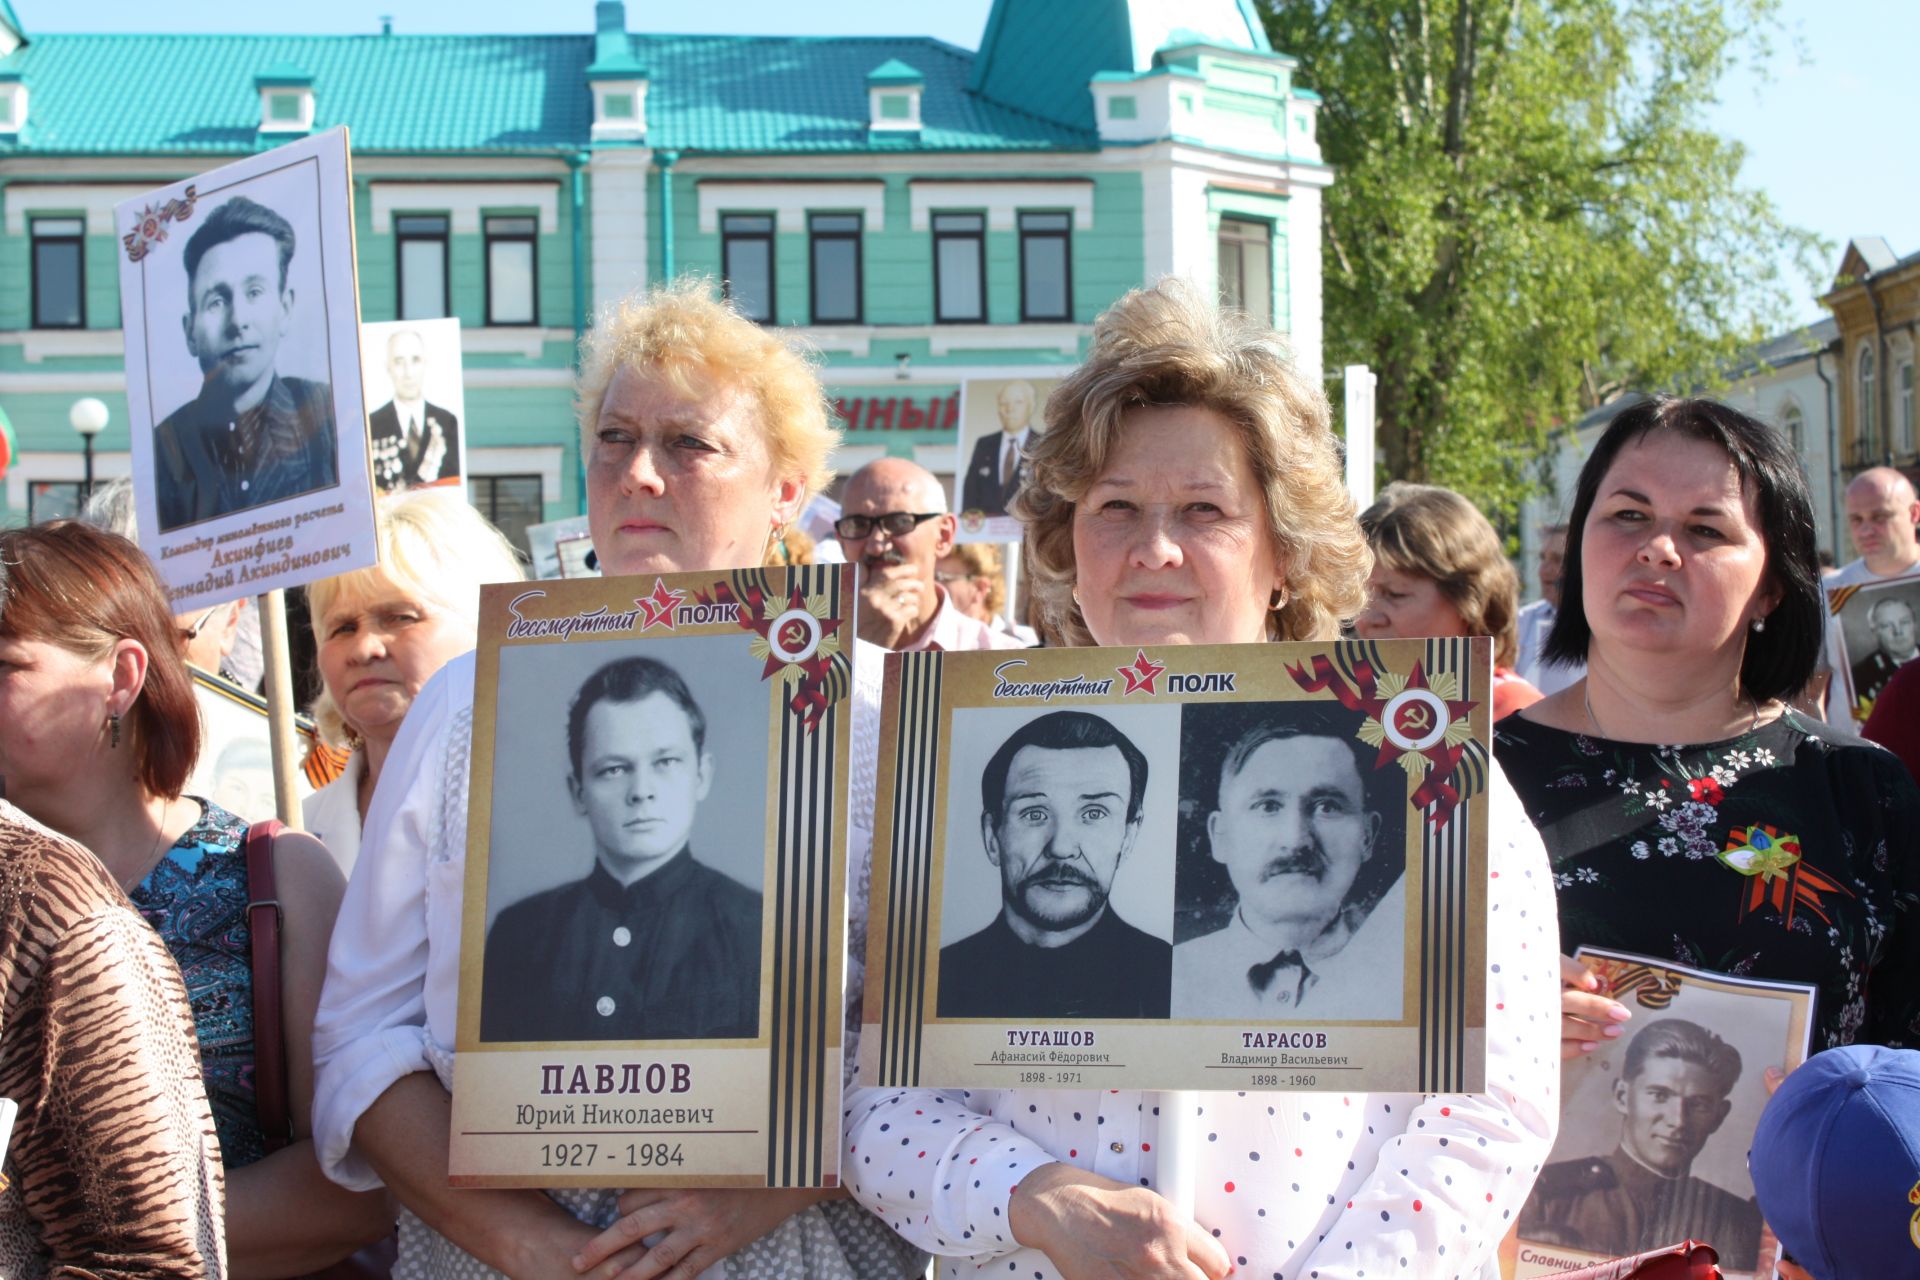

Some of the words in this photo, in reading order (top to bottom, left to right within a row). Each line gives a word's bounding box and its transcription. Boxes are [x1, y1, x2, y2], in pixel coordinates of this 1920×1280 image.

[160, 537, 214, 560] Командир
[210, 535, 293, 568] Акинфиев
[238, 542, 351, 584] Акиндинович
[1007, 1031, 1095, 1046] ТУГАШОВ
[1242, 1032, 1328, 1048] ТАРАСОВ
[990, 1051, 1046, 1063] Афанасий
[1049, 1051, 1109, 1064] Фёдорович
[1221, 1053, 1277, 1066] Владимир
[1281, 1053, 1348, 1065] Васильевич
[540, 1063, 692, 1095] ПАВЛОВ
[1020, 1072, 1045, 1083] 1898
[1056, 1072, 1082, 1083] 1971
[1251, 1075, 1277, 1086] 1898
[1290, 1075, 1316, 1086] 1960
[516, 1104, 576, 1130] Юрий
[582, 1103, 714, 1125] Николаевич
[541, 1143, 598, 1167] 1927
[626, 1143, 684, 1167] 1984
[1520, 1249, 1582, 1271] Славнин
